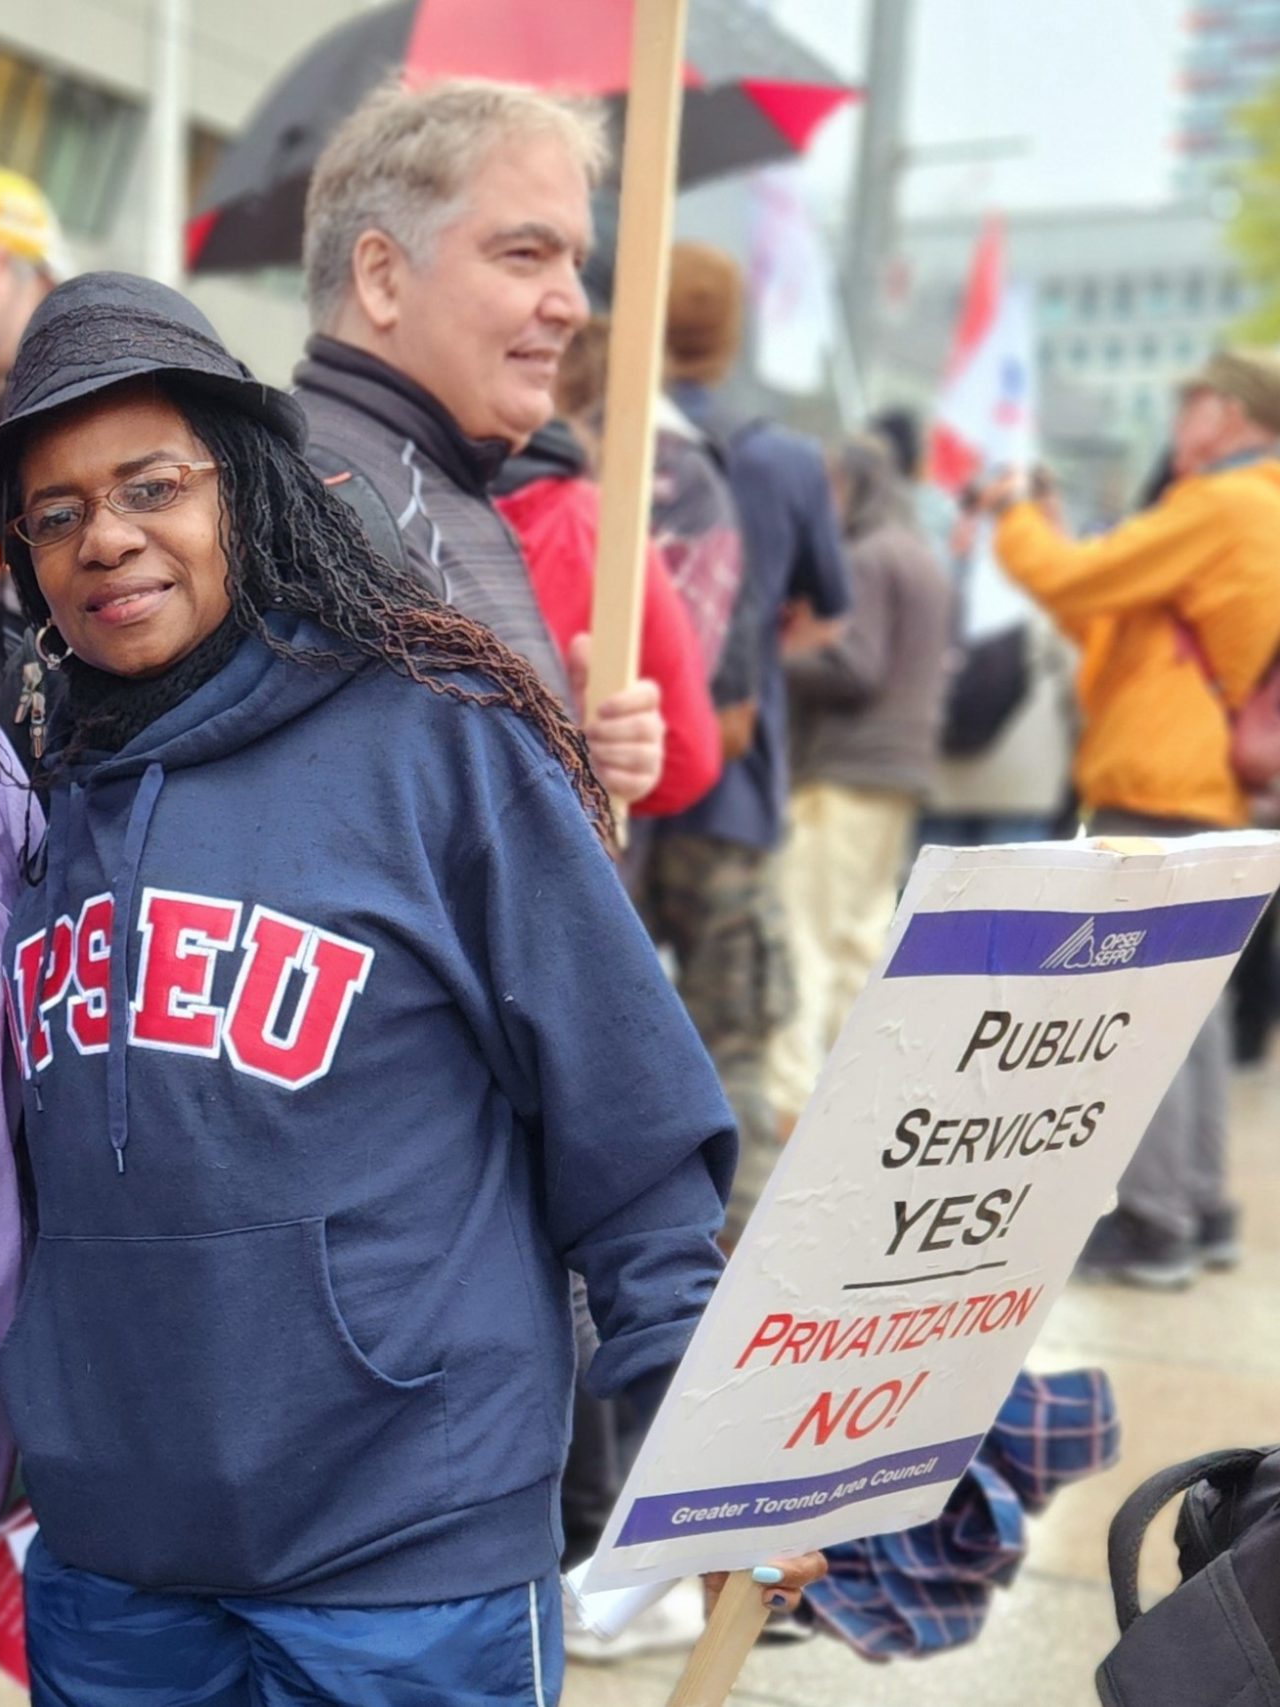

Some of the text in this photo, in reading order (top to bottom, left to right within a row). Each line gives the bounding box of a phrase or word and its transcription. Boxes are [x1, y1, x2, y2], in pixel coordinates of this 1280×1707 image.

[1090, 947, 1136, 967] SEFPO
[1100, 930, 1147, 950] OPSEU
[4, 887, 375, 1091] PSEU
[955, 1010, 1131, 1073] PUBLIC
[881, 1101, 1106, 1169] SERVICES
[884, 1183, 1033, 1256] YES!
[733, 1284, 1045, 1369] PRIVATIZATION
[782, 1371, 930, 1450] NO!
[672, 1457, 938, 1526] Greater Toronto Area Council
